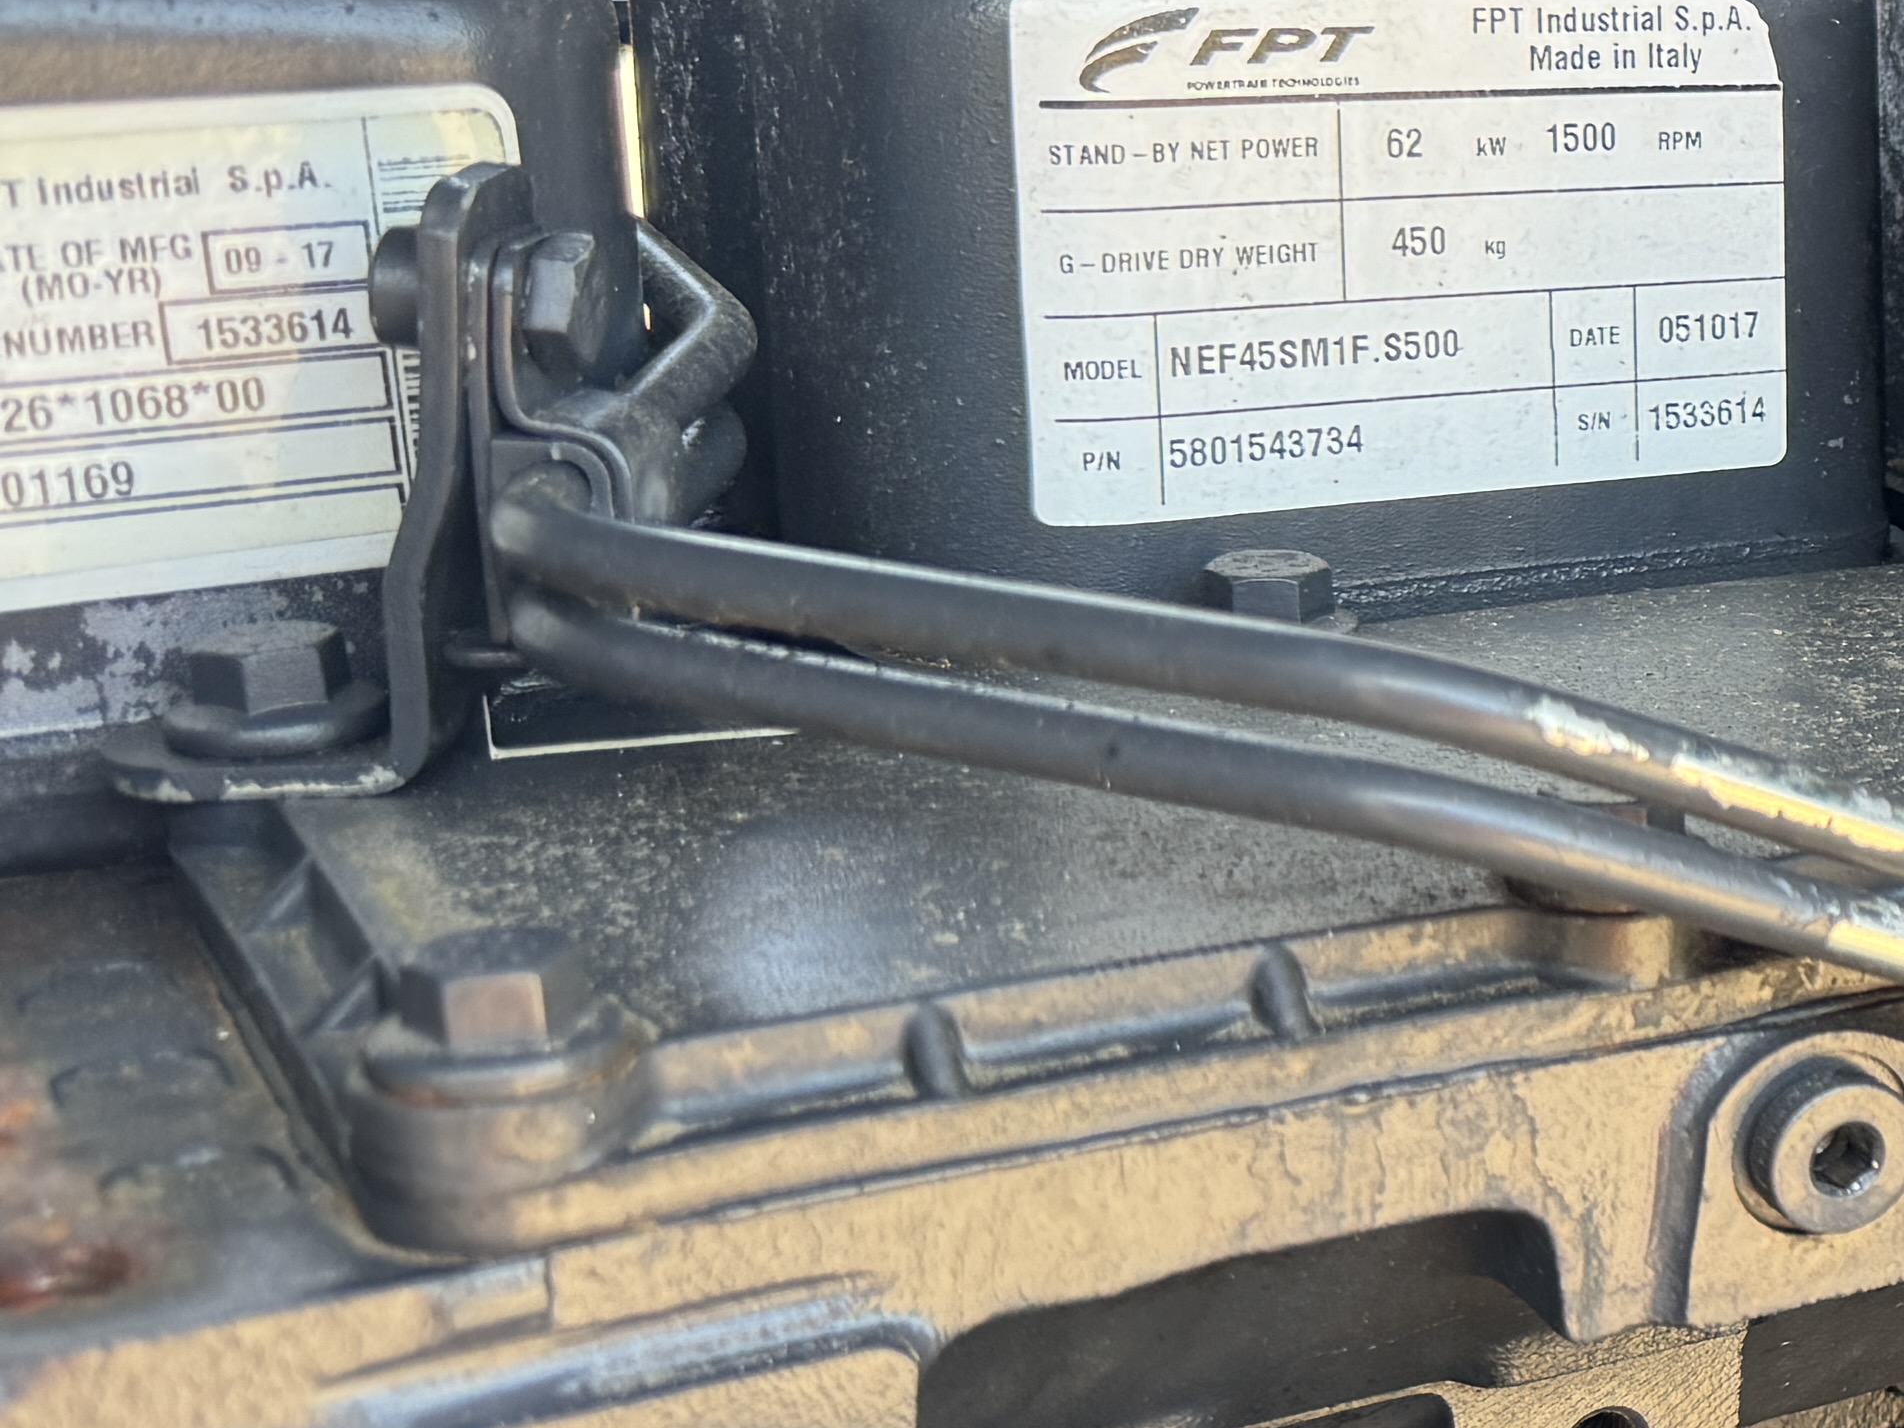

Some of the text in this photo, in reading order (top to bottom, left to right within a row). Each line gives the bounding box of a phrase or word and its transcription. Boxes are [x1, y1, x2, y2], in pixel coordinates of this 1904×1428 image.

[1472, 5, 1752, 35] FPT Industrial S.p.A.
[1190, 26, 1375, 65] FPT
[1530, 42, 1702, 74] Made in Italy
[1191, 140, 1230, 161] NET
[1242, 137, 1319, 160] POWER
[1387, 122, 1702, 158] 62 kW 1500 RPM
[38, 166, 200, 206] Industrial
[228, 161, 332, 198] S.p.A.
[0, 233, 192, 272] TE OF MFG
[225, 246, 262, 273] 09
[302, 241, 334, 269] 17
[1180, 247, 1224, 270] DRY
[1236, 242, 1318, 266] WEIGHT
[1392, 226, 1506, 259] 450 kg
[22, 267, 161, 308] (MO-YR)
[3, 308, 353, 358] NUMBER 1533614
[1570, 311, 1759, 347] DATE 051017
[1063, 328, 1460, 381] MODEL NEF45SM1F.S500
[1578, 396, 1766, 431] S/N 1533614
[1083, 425, 1364, 471] P/N 5801543734
